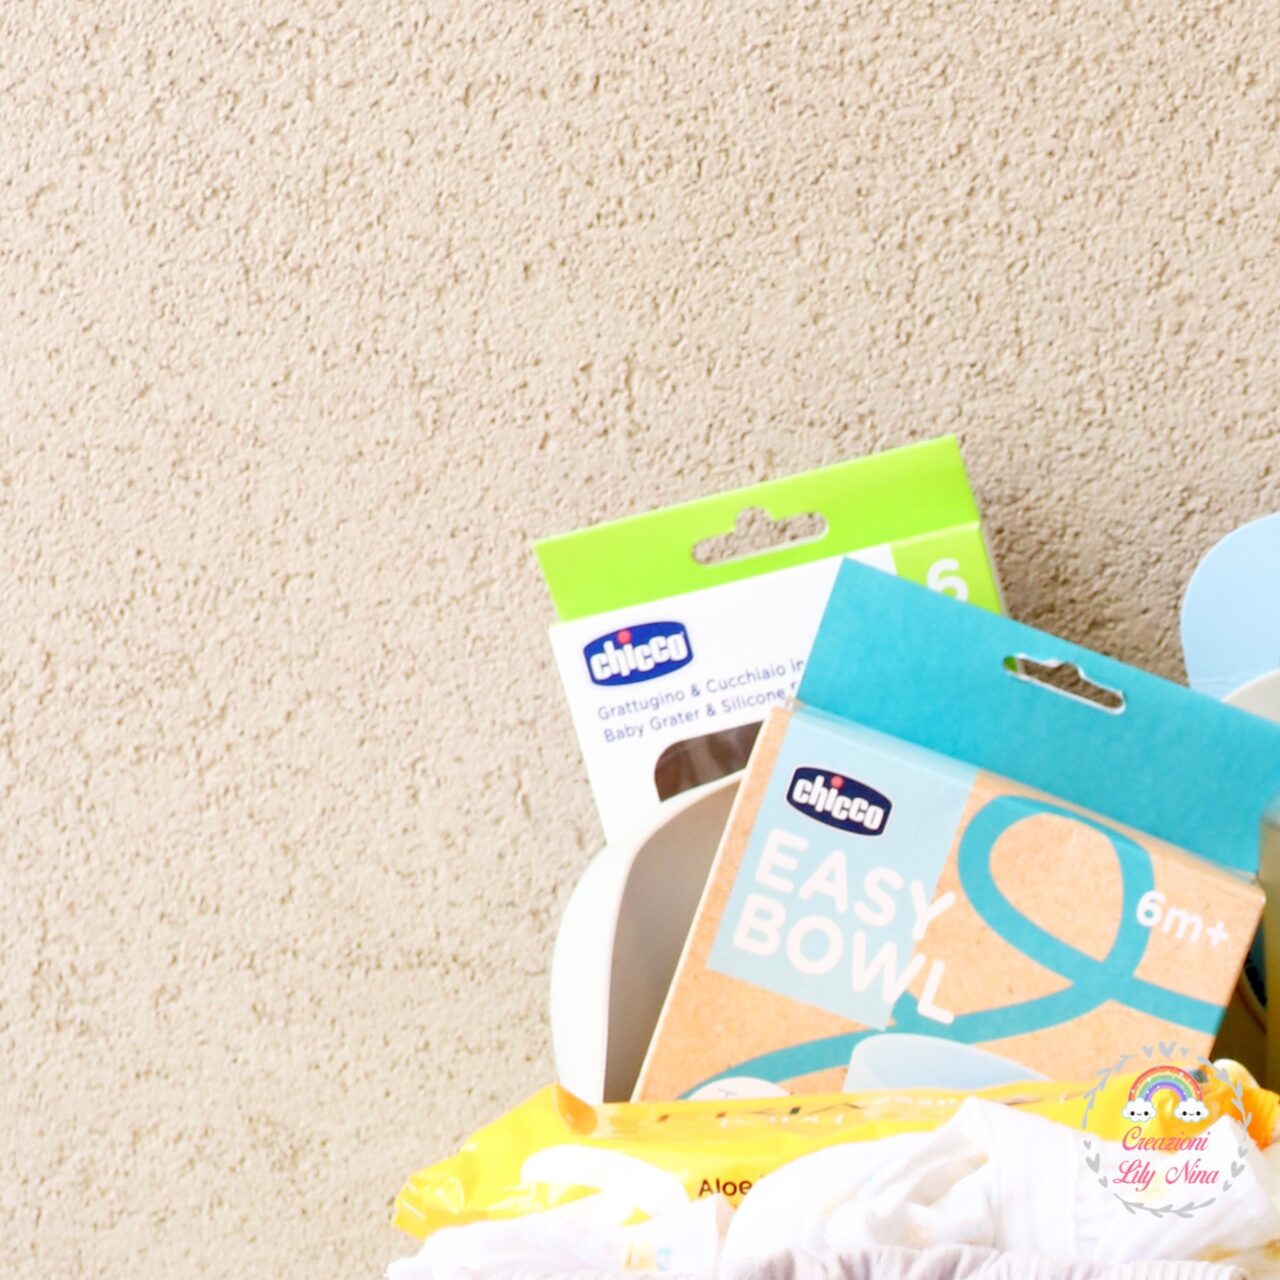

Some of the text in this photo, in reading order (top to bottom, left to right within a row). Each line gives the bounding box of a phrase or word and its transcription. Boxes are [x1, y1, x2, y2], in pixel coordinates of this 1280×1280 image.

[927, 558, 968, 602] 6
[589, 628, 689, 682] chicco
[598, 688, 685, 721] Grattugino
[690, 682, 701, 698] &
[706, 664, 787, 694] Cucchiaio
[603, 690, 785, 744] Baby Grater & Silicone
[792, 774, 885, 831] chicco
[755, 827, 957, 941] EASY
[1136, 890, 1230, 948] 6m+
[733, 892, 955, 1025] BOWL
[698, 1177, 753, 1198] Aloe
